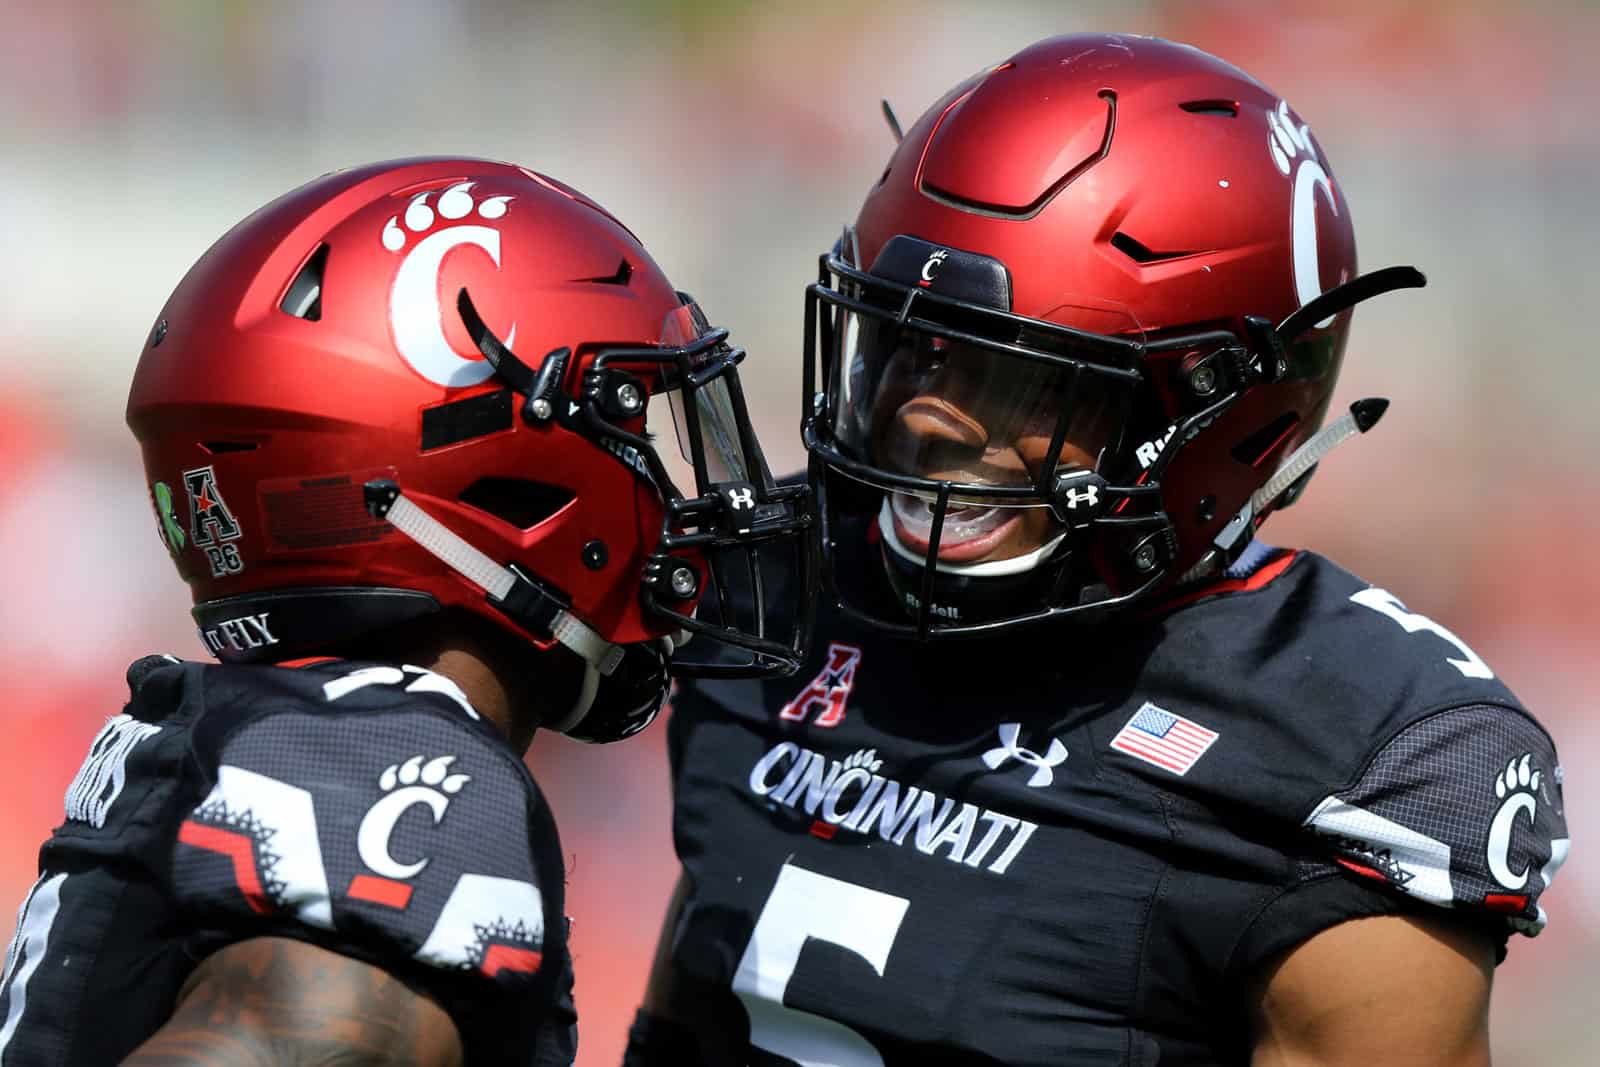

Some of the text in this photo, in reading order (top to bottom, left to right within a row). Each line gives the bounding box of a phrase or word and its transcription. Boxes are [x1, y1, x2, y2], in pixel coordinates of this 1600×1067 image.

[391, 225, 516, 388] C
[183, 465, 242, 547] A
[205, 543, 244, 578] P6
[905, 591, 960, 619] Ridell
[778, 641, 862, 727] A
[357, 786, 450, 879] C
[750, 741, 1039, 875] CINCINNATI
[1487, 792, 1537, 891] C
[731, 862, 911, 1067] 5
